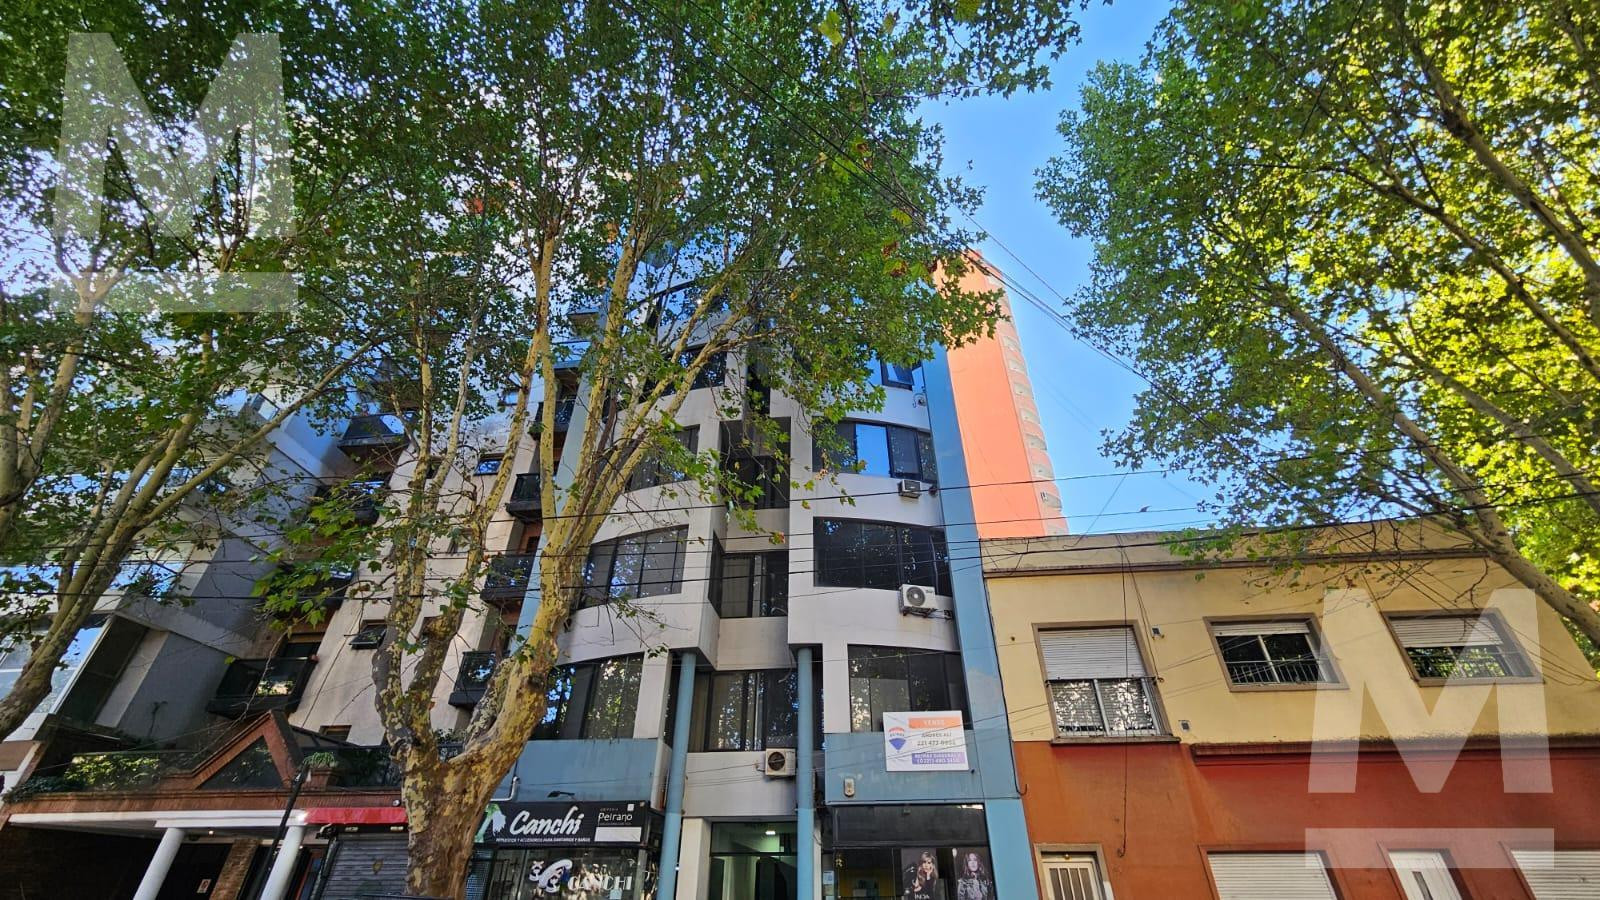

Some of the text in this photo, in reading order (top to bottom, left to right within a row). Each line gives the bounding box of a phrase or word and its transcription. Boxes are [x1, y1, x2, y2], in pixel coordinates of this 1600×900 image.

[509, 805, 585, 835] Canchi
[597, 812, 633, 824] Peirano
[567, 875, 633, 891] CANCHI
